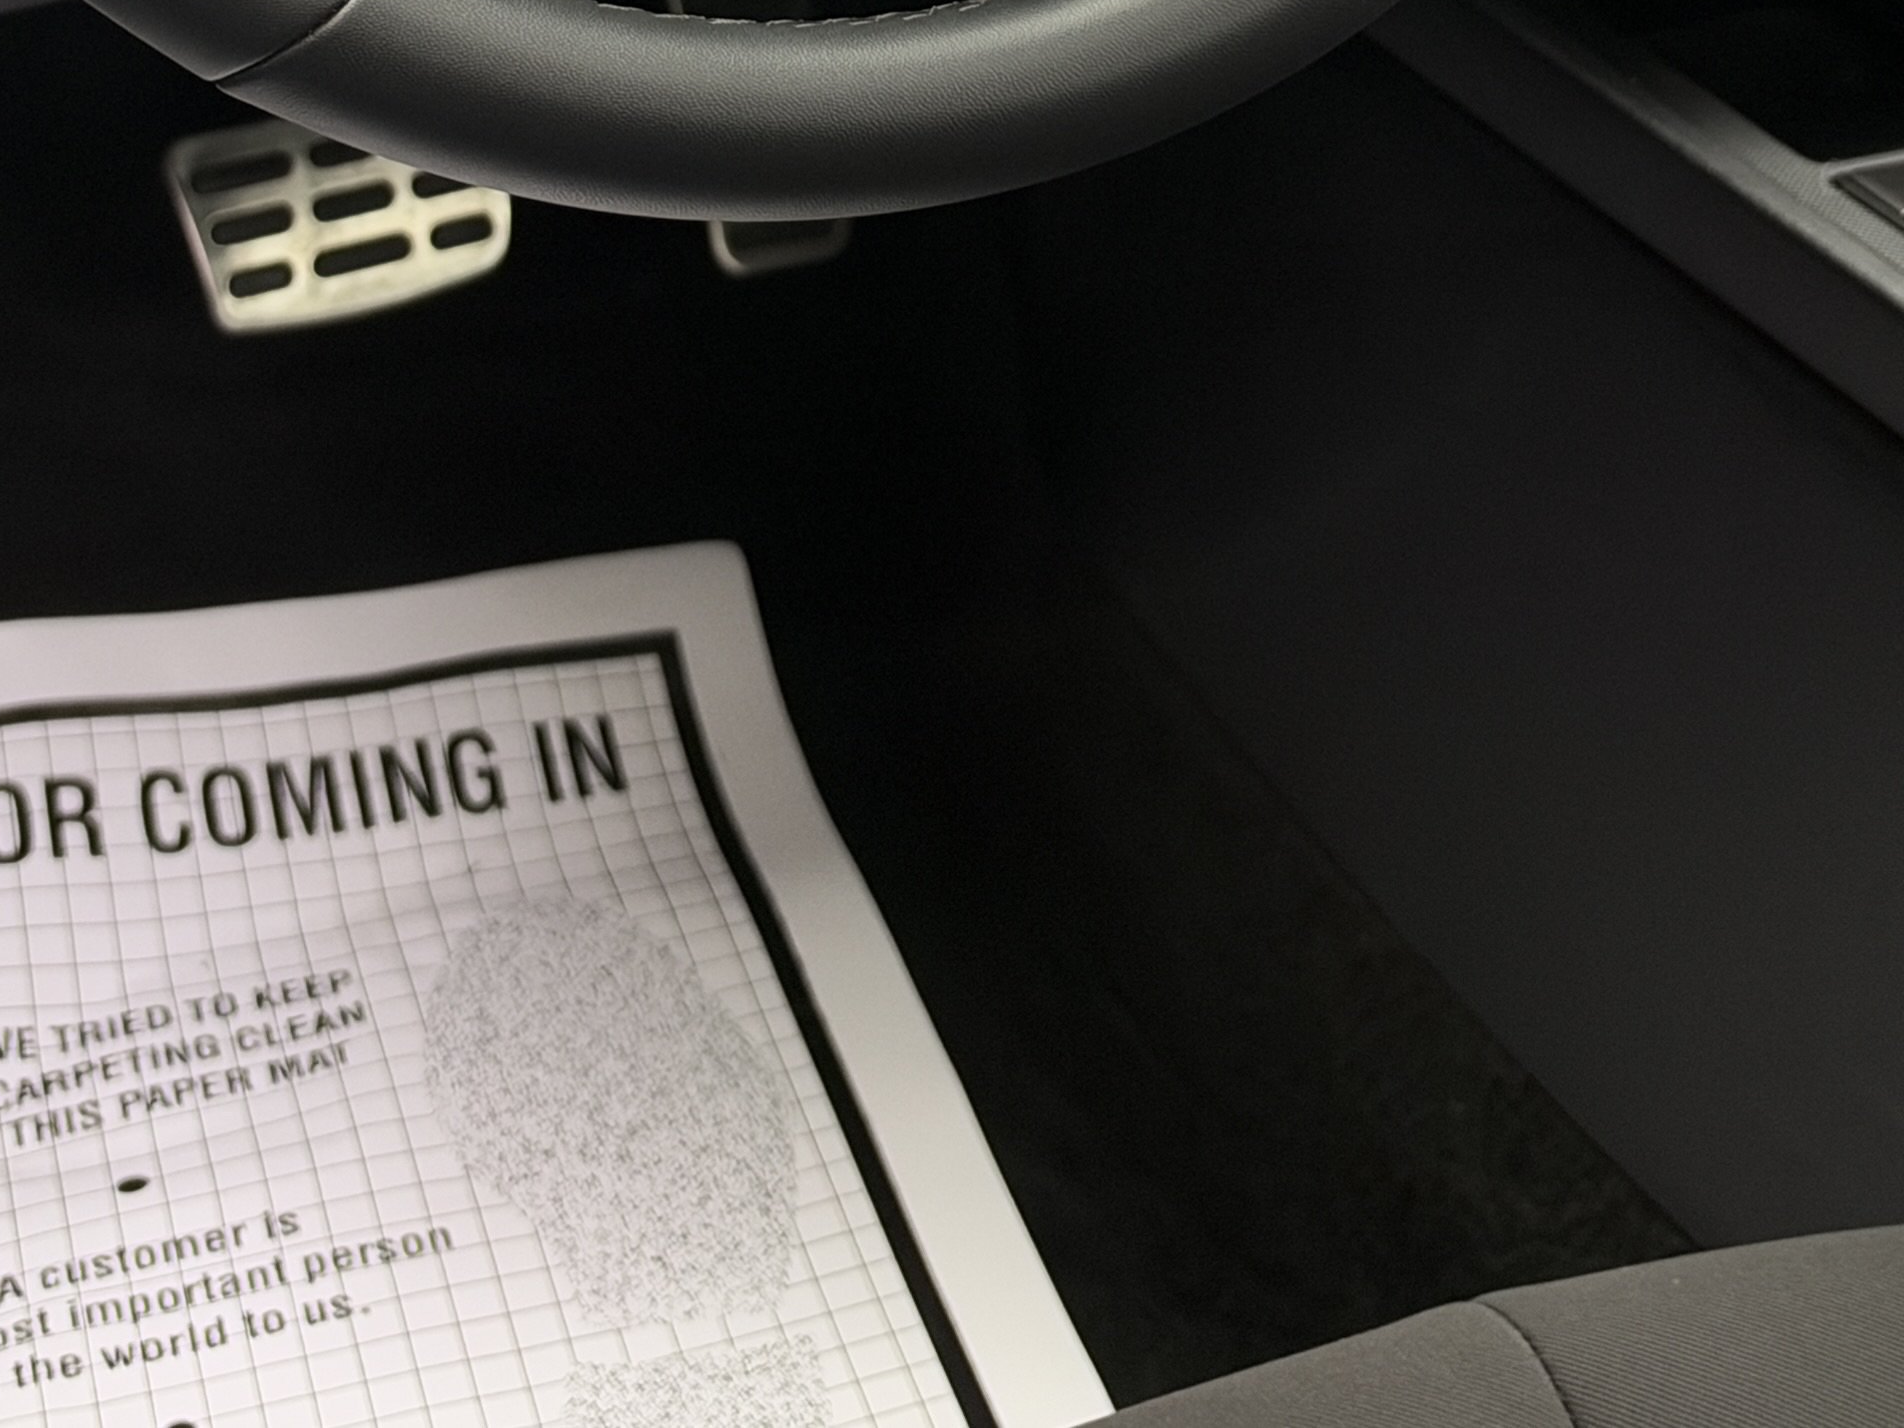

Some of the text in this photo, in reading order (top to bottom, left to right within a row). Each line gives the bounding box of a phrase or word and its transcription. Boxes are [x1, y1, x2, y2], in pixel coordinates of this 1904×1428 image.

[139, 727, 507, 856] COMING
[531, 712, 630, 803] IN
[50, 1003, 174, 1052] TRIED
[186, 989, 240, 1024] TO
[253, 967, 353, 1011] KEEP
[238, 999, 368, 1053] CLEAN
[11, 1098, 104, 1148] THIS
[120, 1070, 254, 1121] PAPER
[268, 1039, 355, 1086] MAT
[39, 1221, 249, 1291] customer
[263, 1209, 302, 1240] is
[68, 1252, 288, 1331] important
[302, 1221, 456, 1284] person
[12, 1345, 85, 1389] the
[100, 1314, 230, 1371] world
[241, 1305, 287, 1340] to
[302, 1292, 372, 1327] us.
